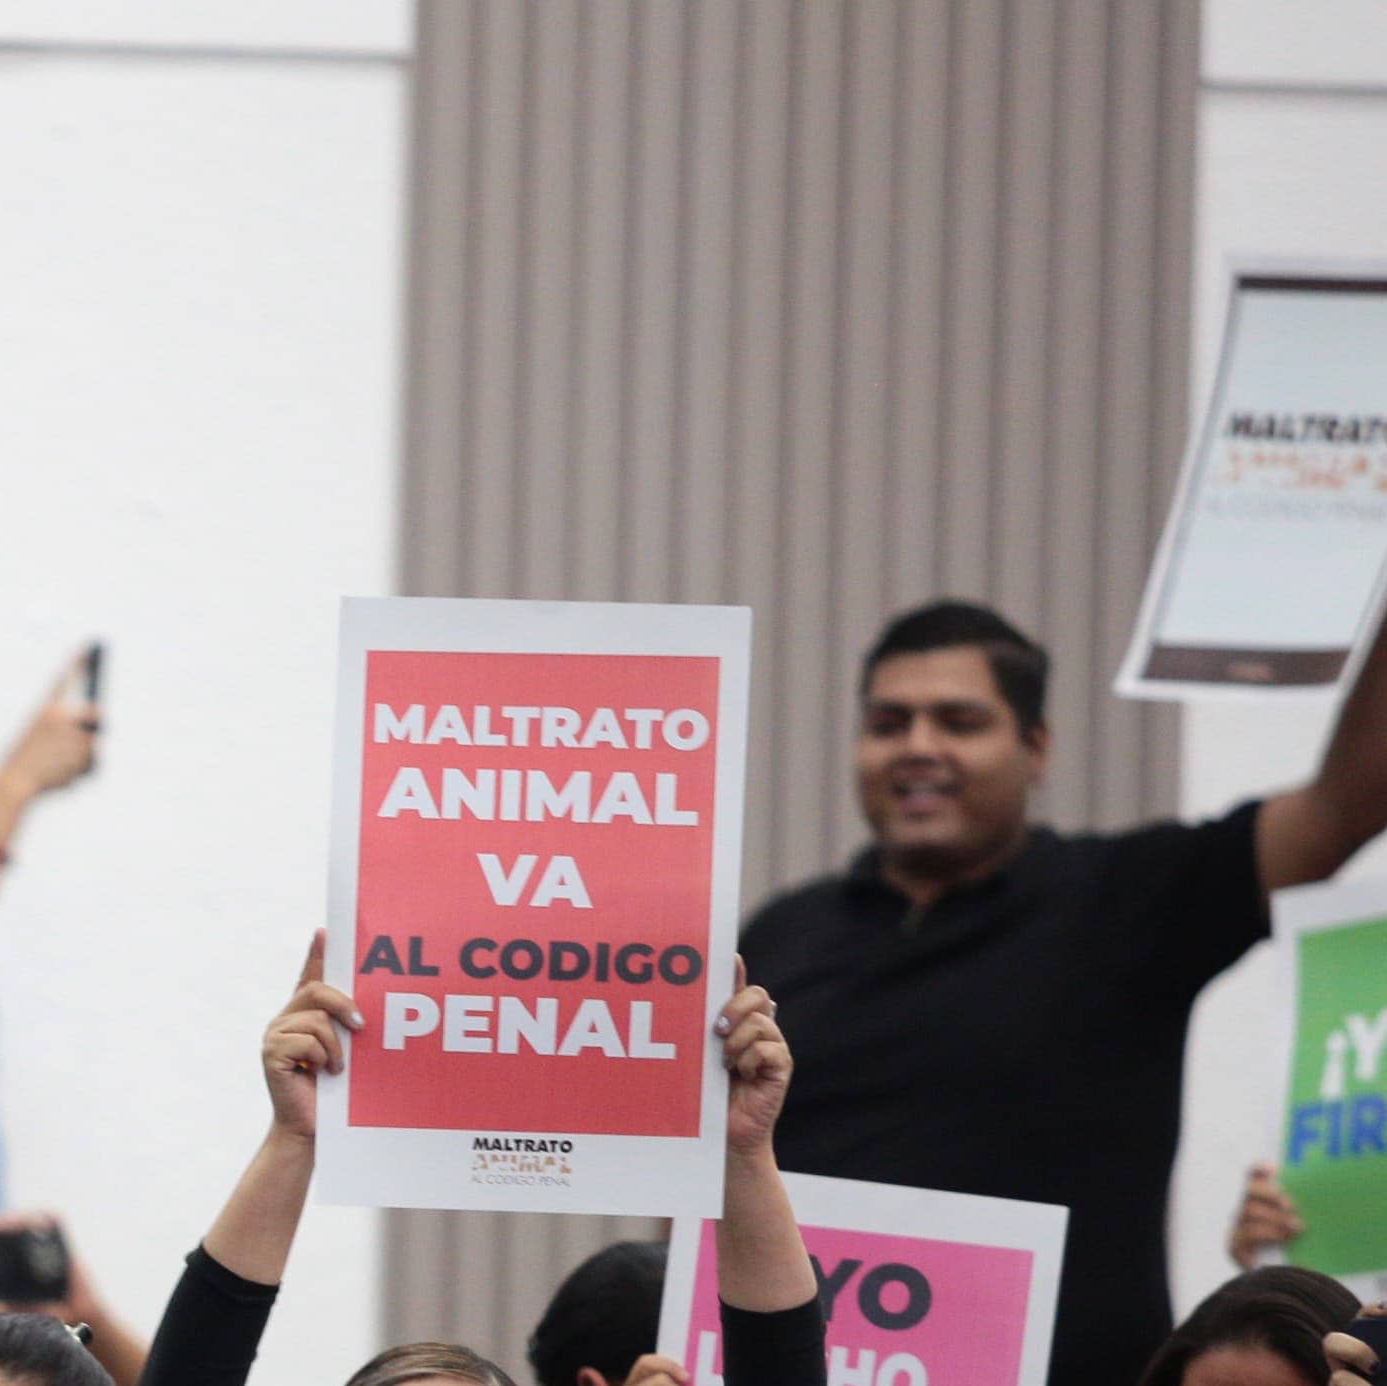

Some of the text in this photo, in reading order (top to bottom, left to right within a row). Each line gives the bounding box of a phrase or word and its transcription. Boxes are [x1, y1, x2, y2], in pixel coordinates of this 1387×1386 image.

[373, 703, 710, 751] MALTRATO
[377, 767, 699, 826] ANIMAL
[477, 853, 593, 908] VA
[359, 935, 703, 986] AL CODIGO
[382, 991, 677, 1061] PENAL
[473, 1137, 574, 1153] MALTRATO
[809, 1254, 932, 1331] YO
